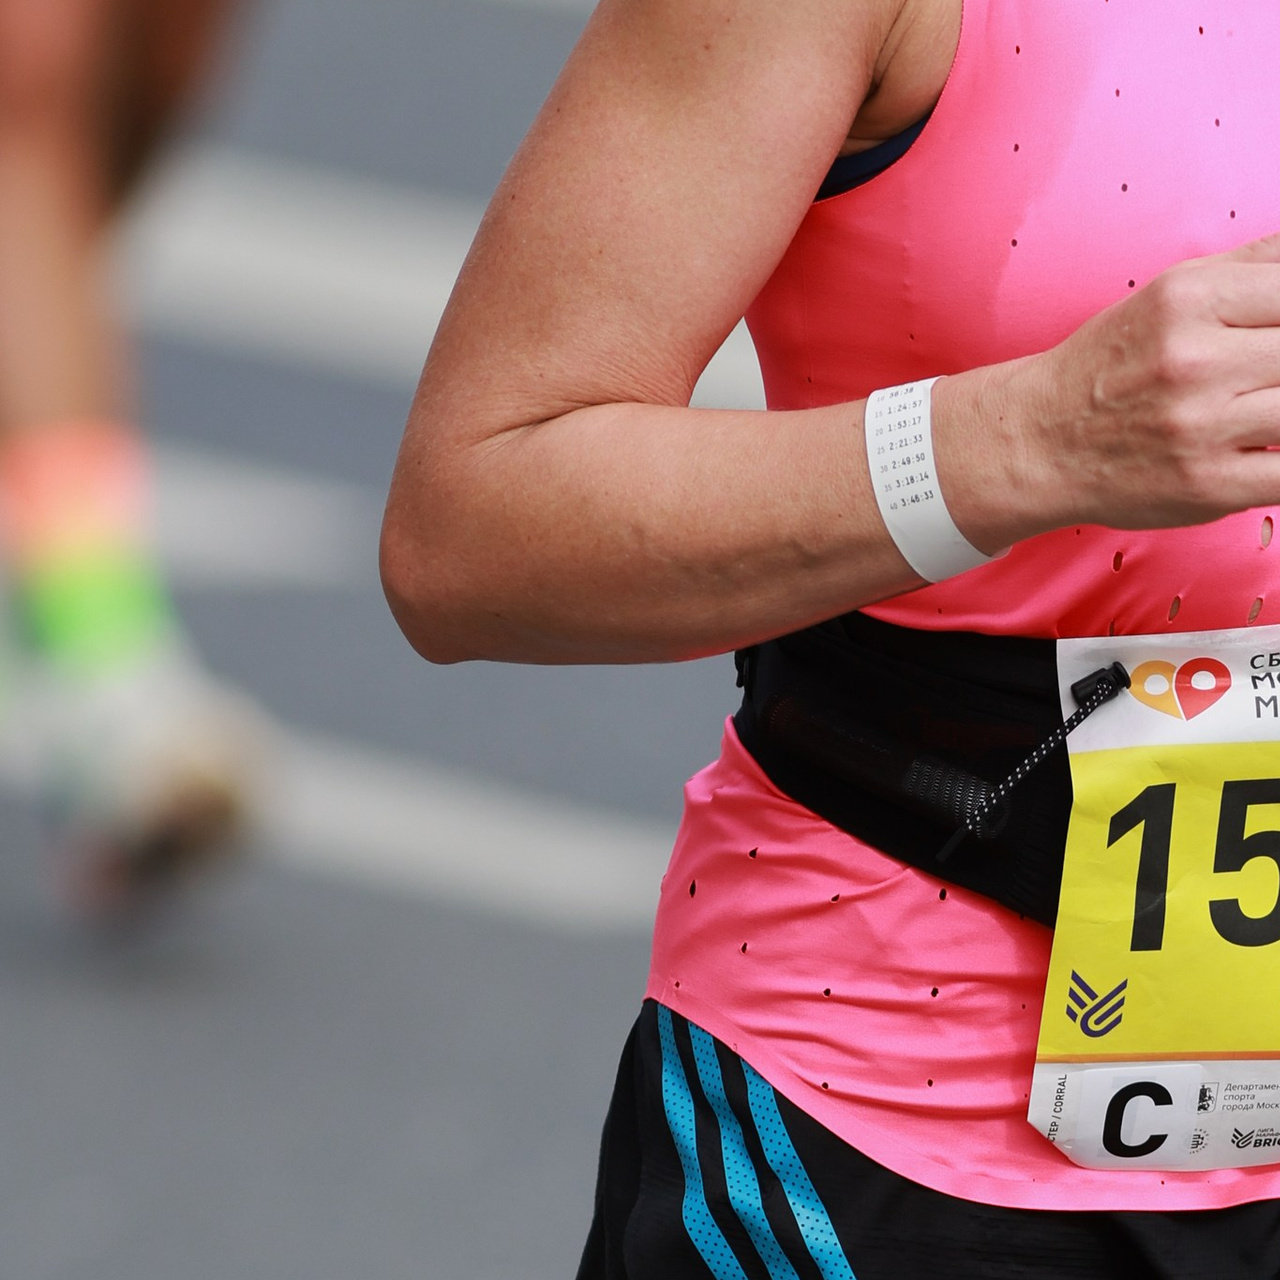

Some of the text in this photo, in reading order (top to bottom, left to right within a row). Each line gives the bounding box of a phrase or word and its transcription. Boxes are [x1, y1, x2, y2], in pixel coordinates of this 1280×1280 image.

[888, 416, 921, 432] 1:53:17
[892, 452, 925, 469] 2:49:50
[896, 471, 929, 488] 3:18:14
[1053, 1074, 1067, 1113] CORRAL
[1223, 1094, 1256, 1102] спорта
[1222, 1103, 1254, 1112] города
